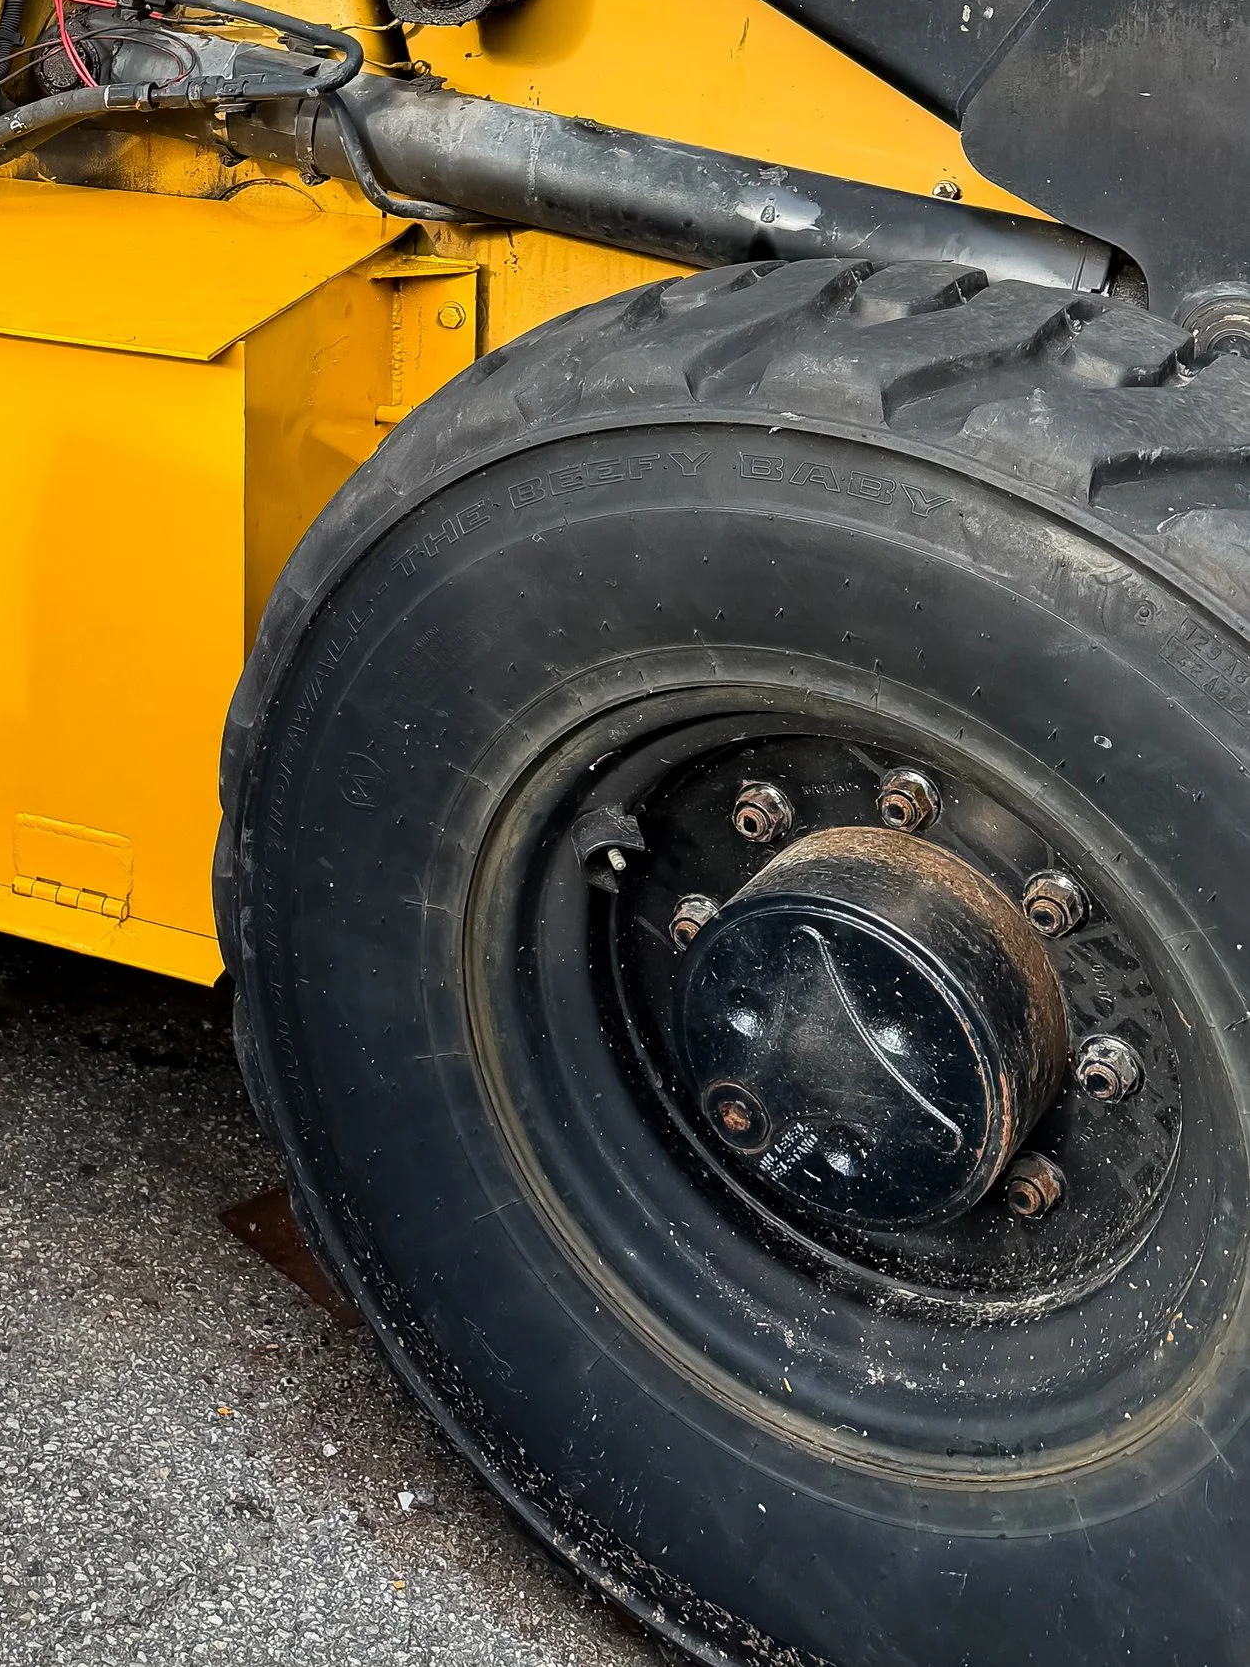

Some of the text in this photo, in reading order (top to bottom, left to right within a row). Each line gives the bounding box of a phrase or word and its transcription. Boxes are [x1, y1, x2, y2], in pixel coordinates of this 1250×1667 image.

[390, 499, 491, 577] THE
[508, 451, 712, 510] BEEFY
[738, 451, 955, 520] BABY
